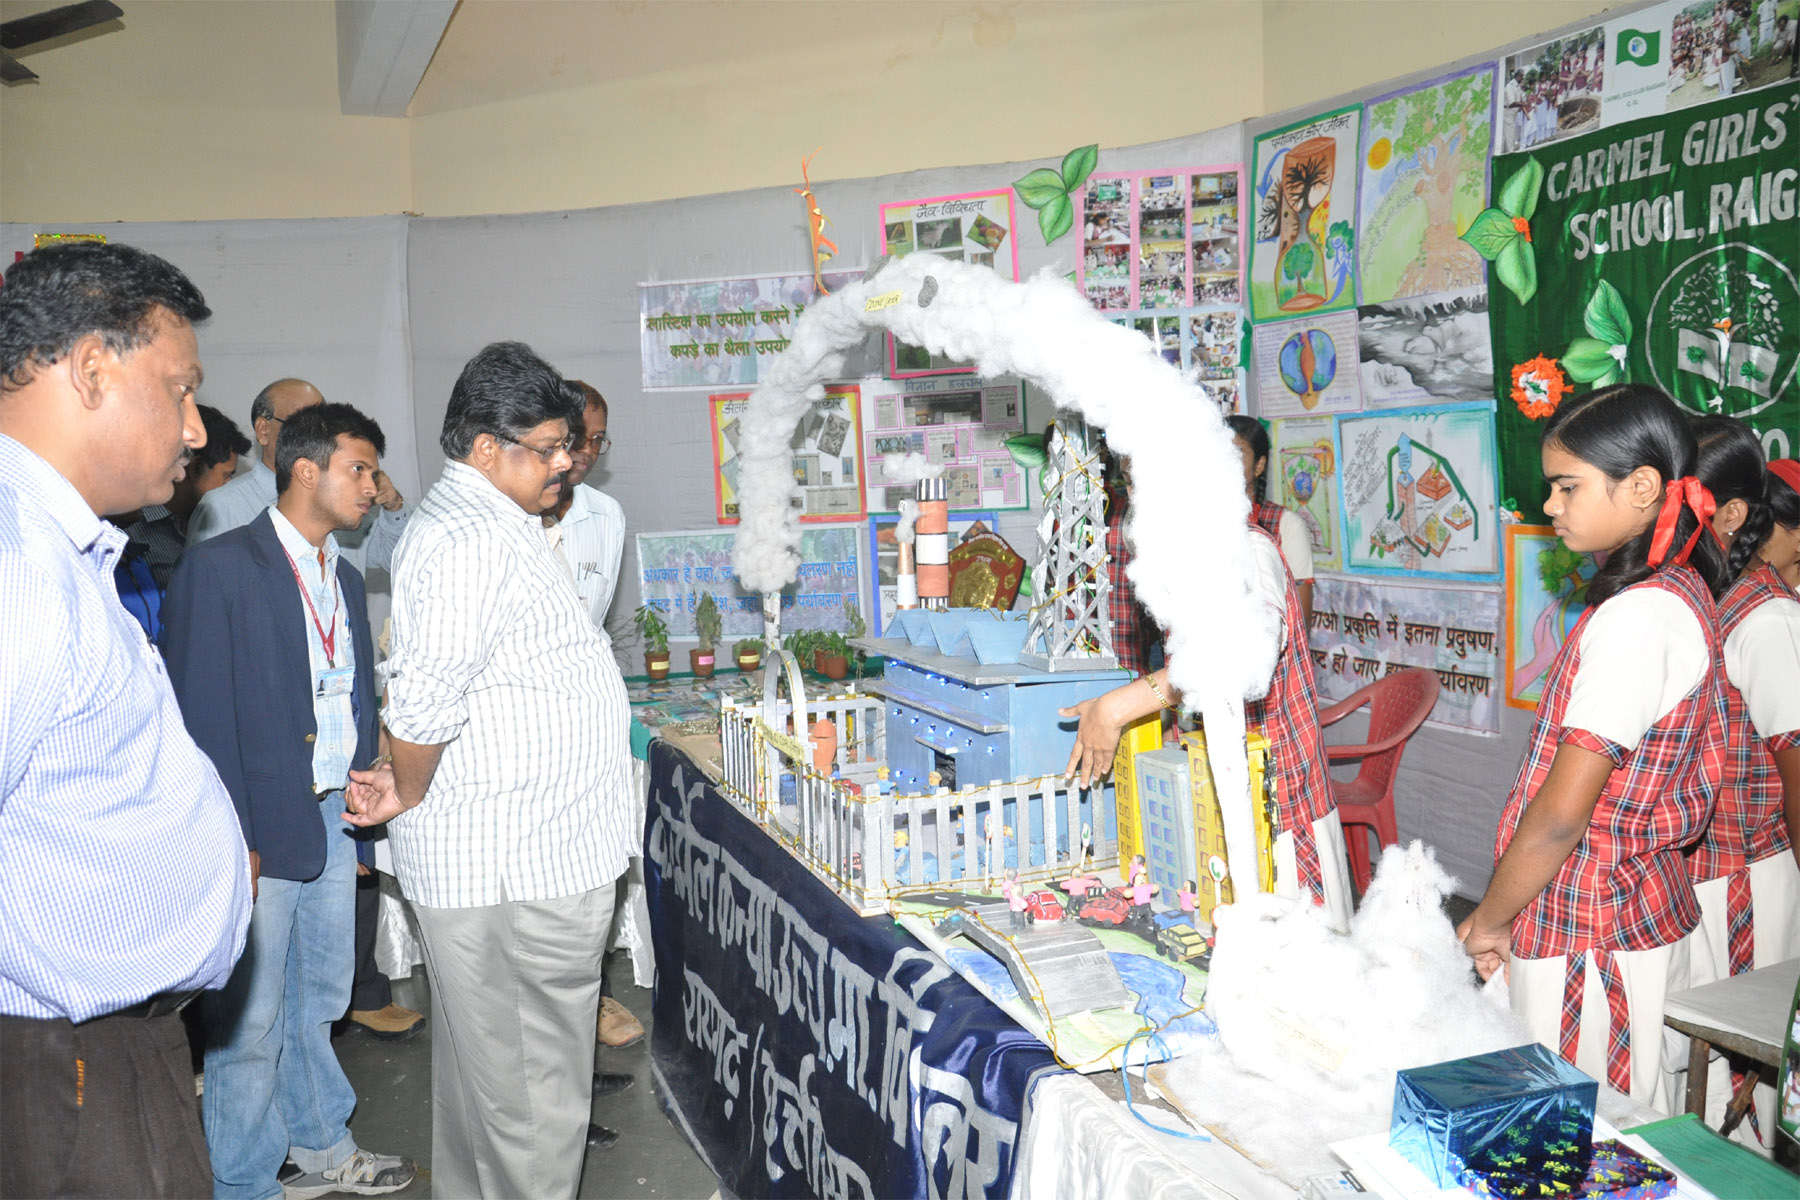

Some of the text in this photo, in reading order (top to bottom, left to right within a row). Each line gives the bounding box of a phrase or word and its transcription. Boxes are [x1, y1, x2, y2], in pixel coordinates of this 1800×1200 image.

[1546, 129, 1671, 202] CARMEL
[1570, 168, 1800, 261] SCHOOL, RAIG
[696, 313, 712, 329] का
[716, 305, 756, 328] उपयोग
[760, 304, 791, 325] करने
[703, 342, 719, 358] का
[724, 336, 750, 357] थैला
[754, 334, 791, 356] उपयो
[1343, 611, 1380, 645] प्रकृति
[1386, 613, 1399, 640] में
[1404, 622, 1441, 648] इतना
[1332, 646, 1348, 676] हो
